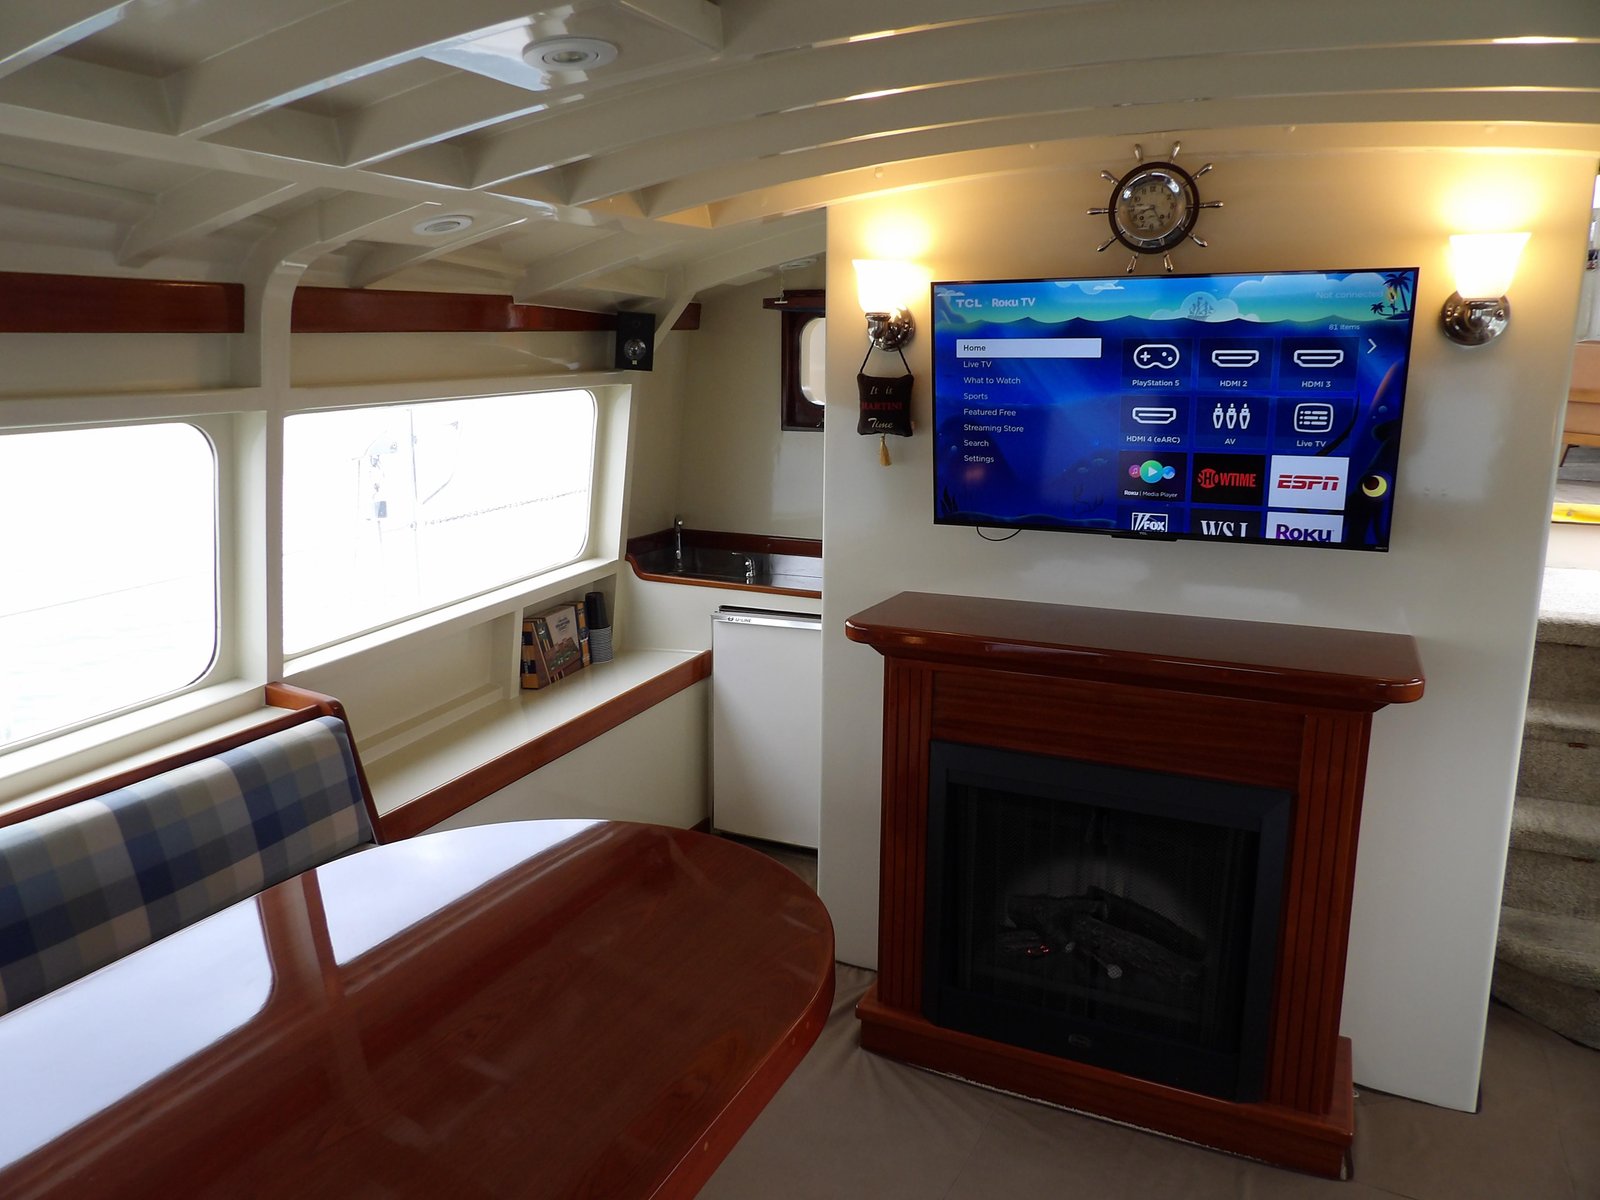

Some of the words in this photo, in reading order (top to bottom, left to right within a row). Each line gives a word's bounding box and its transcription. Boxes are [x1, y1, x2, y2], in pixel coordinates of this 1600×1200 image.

[956, 299, 982, 308] TCL
[992, 298, 1018, 307] Roku
[1021, 298, 1035, 307] TV
[963, 360, 979, 368] Live
[963, 376, 985, 384] What
[986, 376, 994, 384] to
[1132, 380, 1173, 388] PlayStation
[1174, 379, 1179, 387] 5
[963, 393, 988, 401] Sports
[868, 418, 893, 428] Time
[963, 424, 1001, 433] Streaming
[1004, 425, 1024, 433] Store
[963, 439, 989, 447] Search
[1154, 436, 1181, 445] (eARC)
[1296, 439, 1313, 447] Live
[963, 454, 995, 463] Settings
[1197, 468, 1257, 488] SHOWTIME
[1277, 474, 1340, 491] ESPN
[1160, 491, 1178, 499] Player
[1143, 521, 1165, 531] FOX
